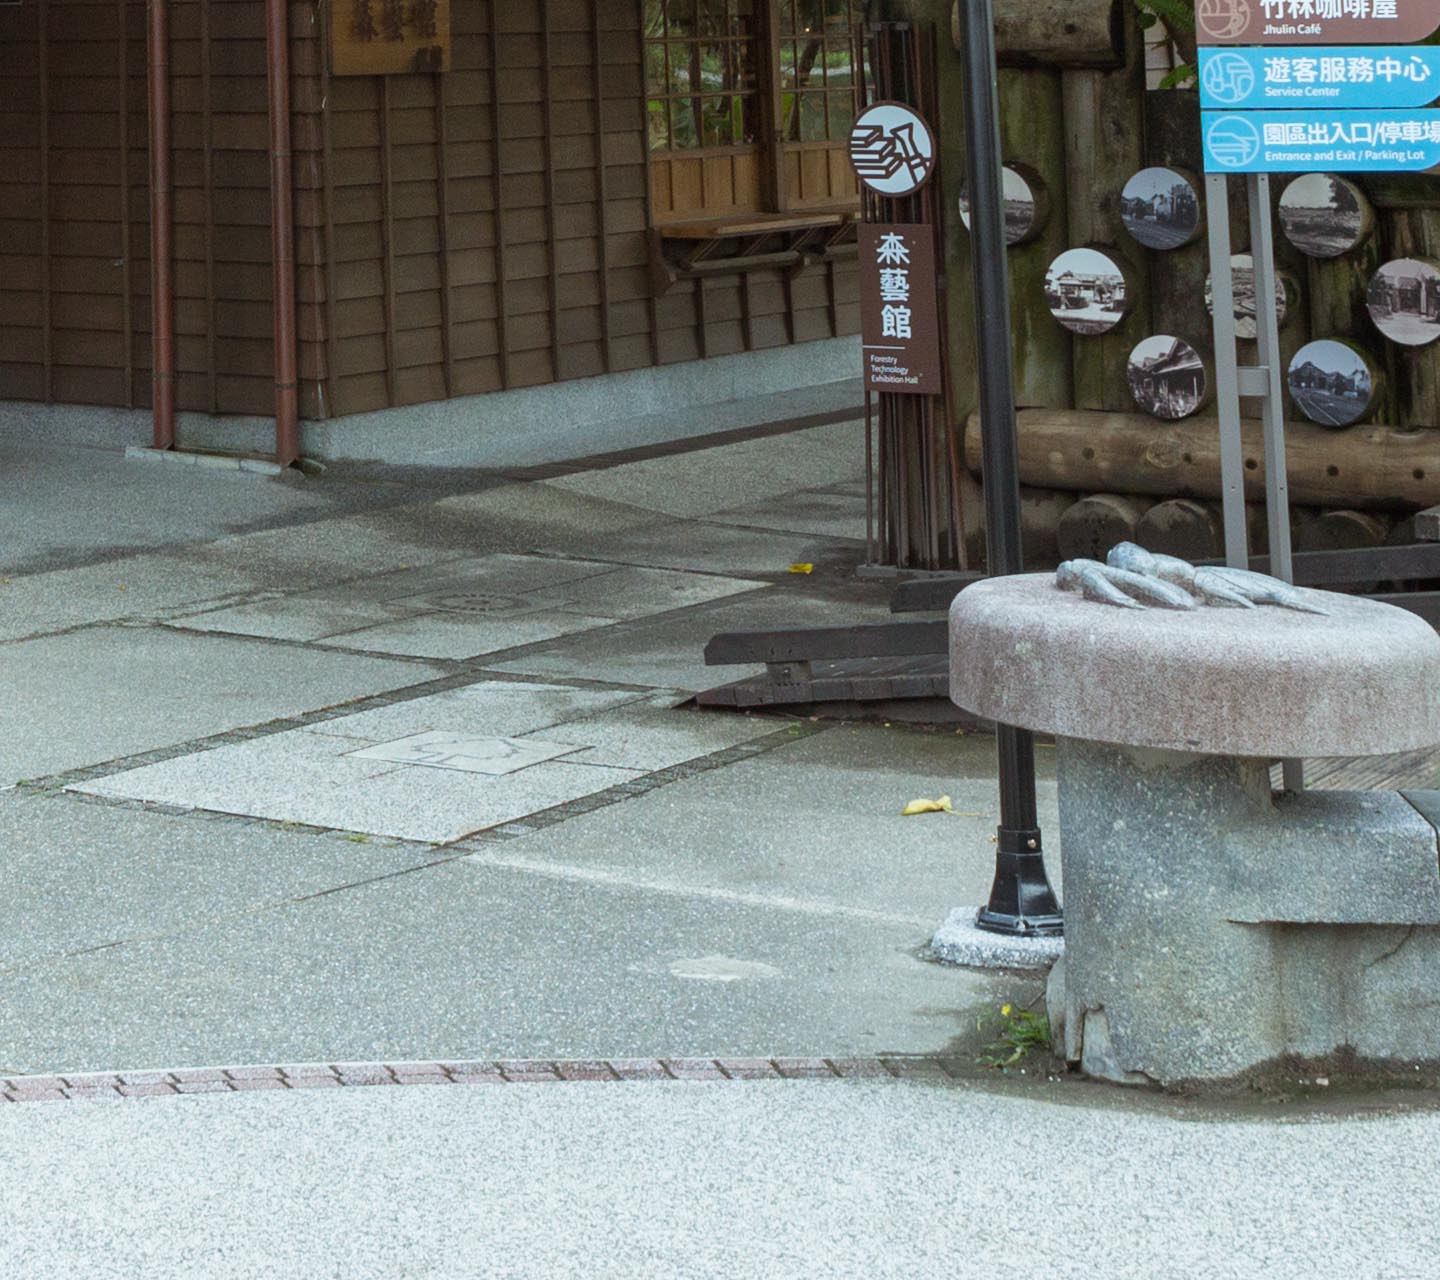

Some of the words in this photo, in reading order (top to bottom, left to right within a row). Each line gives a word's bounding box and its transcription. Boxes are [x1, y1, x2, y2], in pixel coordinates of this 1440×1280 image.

[1263, 24, 1296, 35] Jhulin
[1297, 23, 1322, 35] Café
[1264, 55, 1431, 84] 遊客服務中心
[1265, 87, 1303, 97] Service
[1304, 87, 1340, 97] Center
[1265, 151, 1312, 162] Entrance
[1313, 150, 1334, 161] and
[1336, 150, 1356, 160] Exit
[1365, 150, 1406, 163] Parking
[1407, 150, 1425, 160] Lot
[870, 354, 898, 365] Forestry
[871, 364, 909, 375] Technology
[871, 374, 905, 383] Exhibition
[904, 376, 919, 384] Hall
